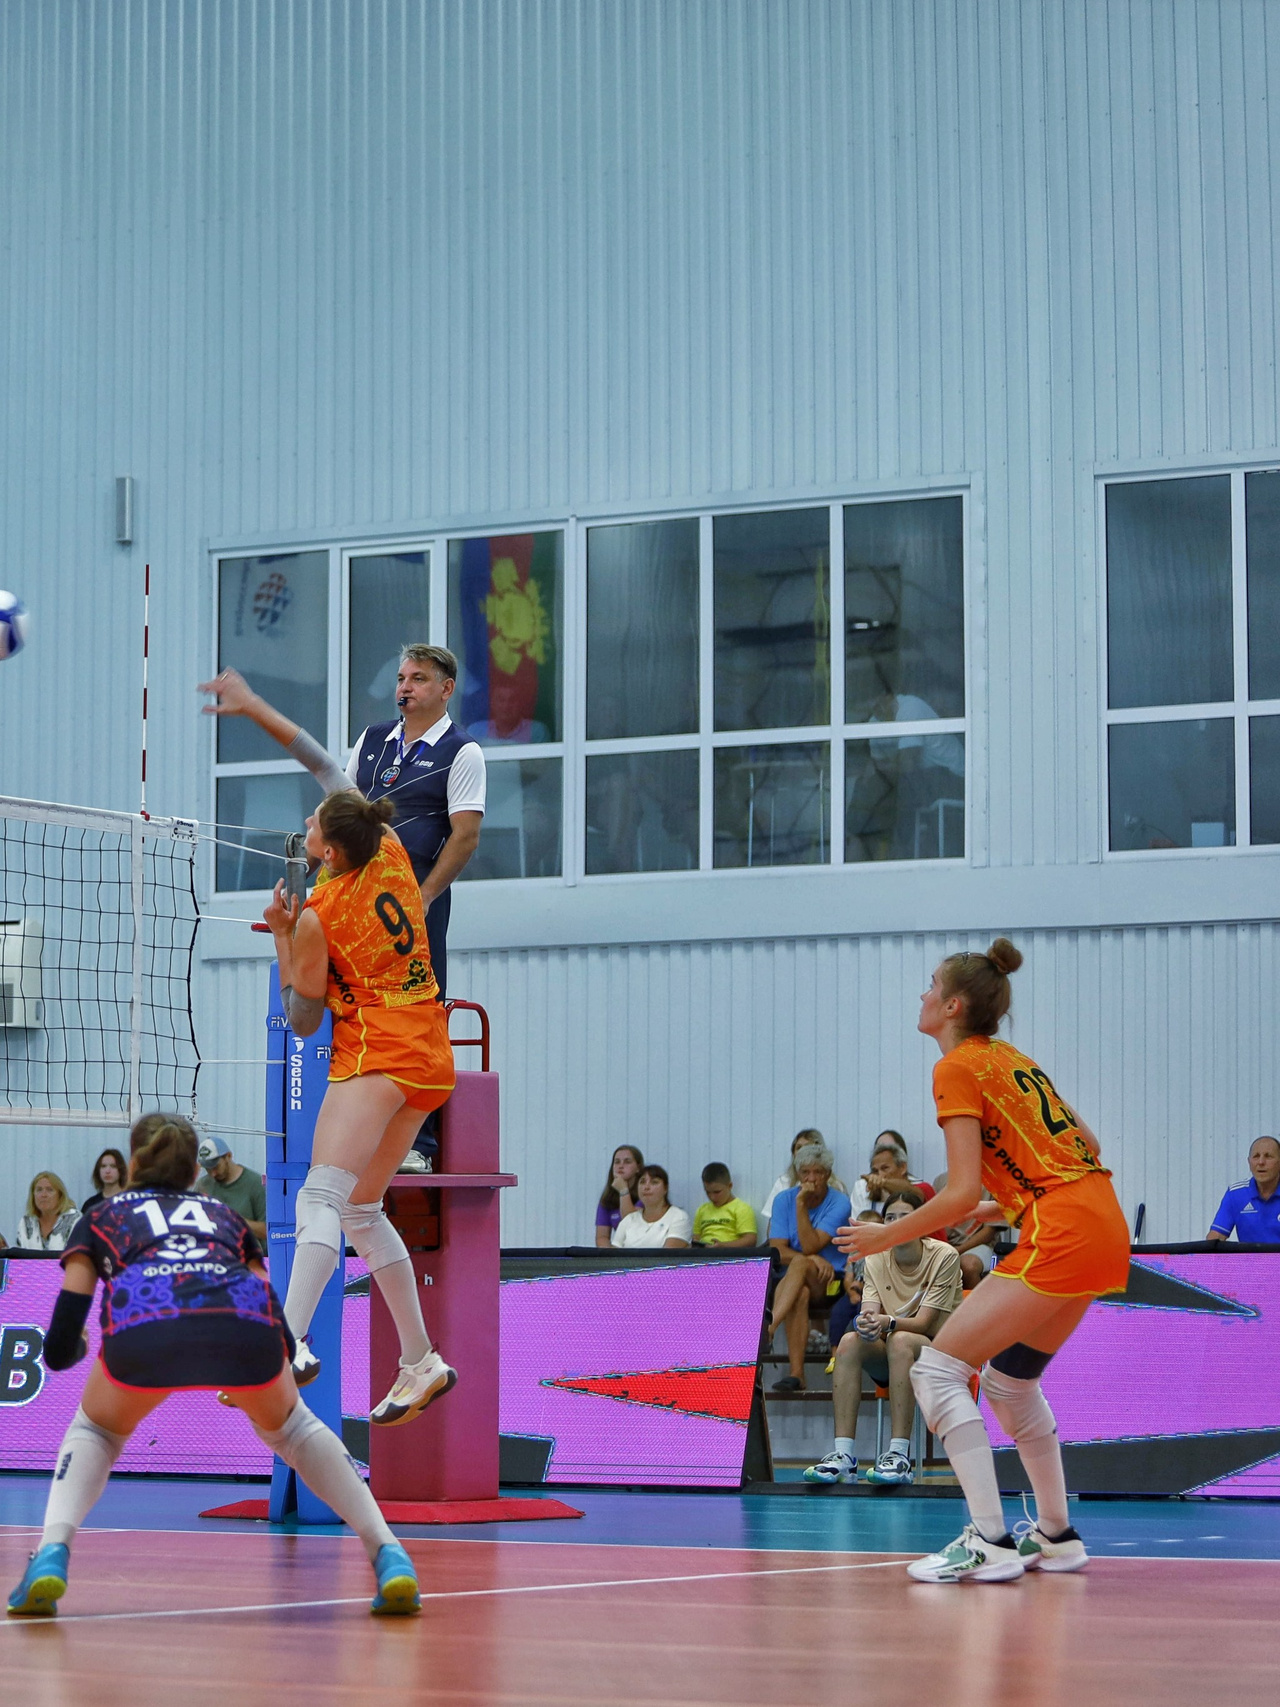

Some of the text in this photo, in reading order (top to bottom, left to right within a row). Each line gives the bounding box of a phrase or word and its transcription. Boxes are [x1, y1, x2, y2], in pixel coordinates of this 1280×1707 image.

[375, 891, 415, 956] 9
[290, 1054, 303, 1110] Senoh
[132, 1199, 218, 1238] 14
[142, 1262, 228, 1278] ФОСАГРО
